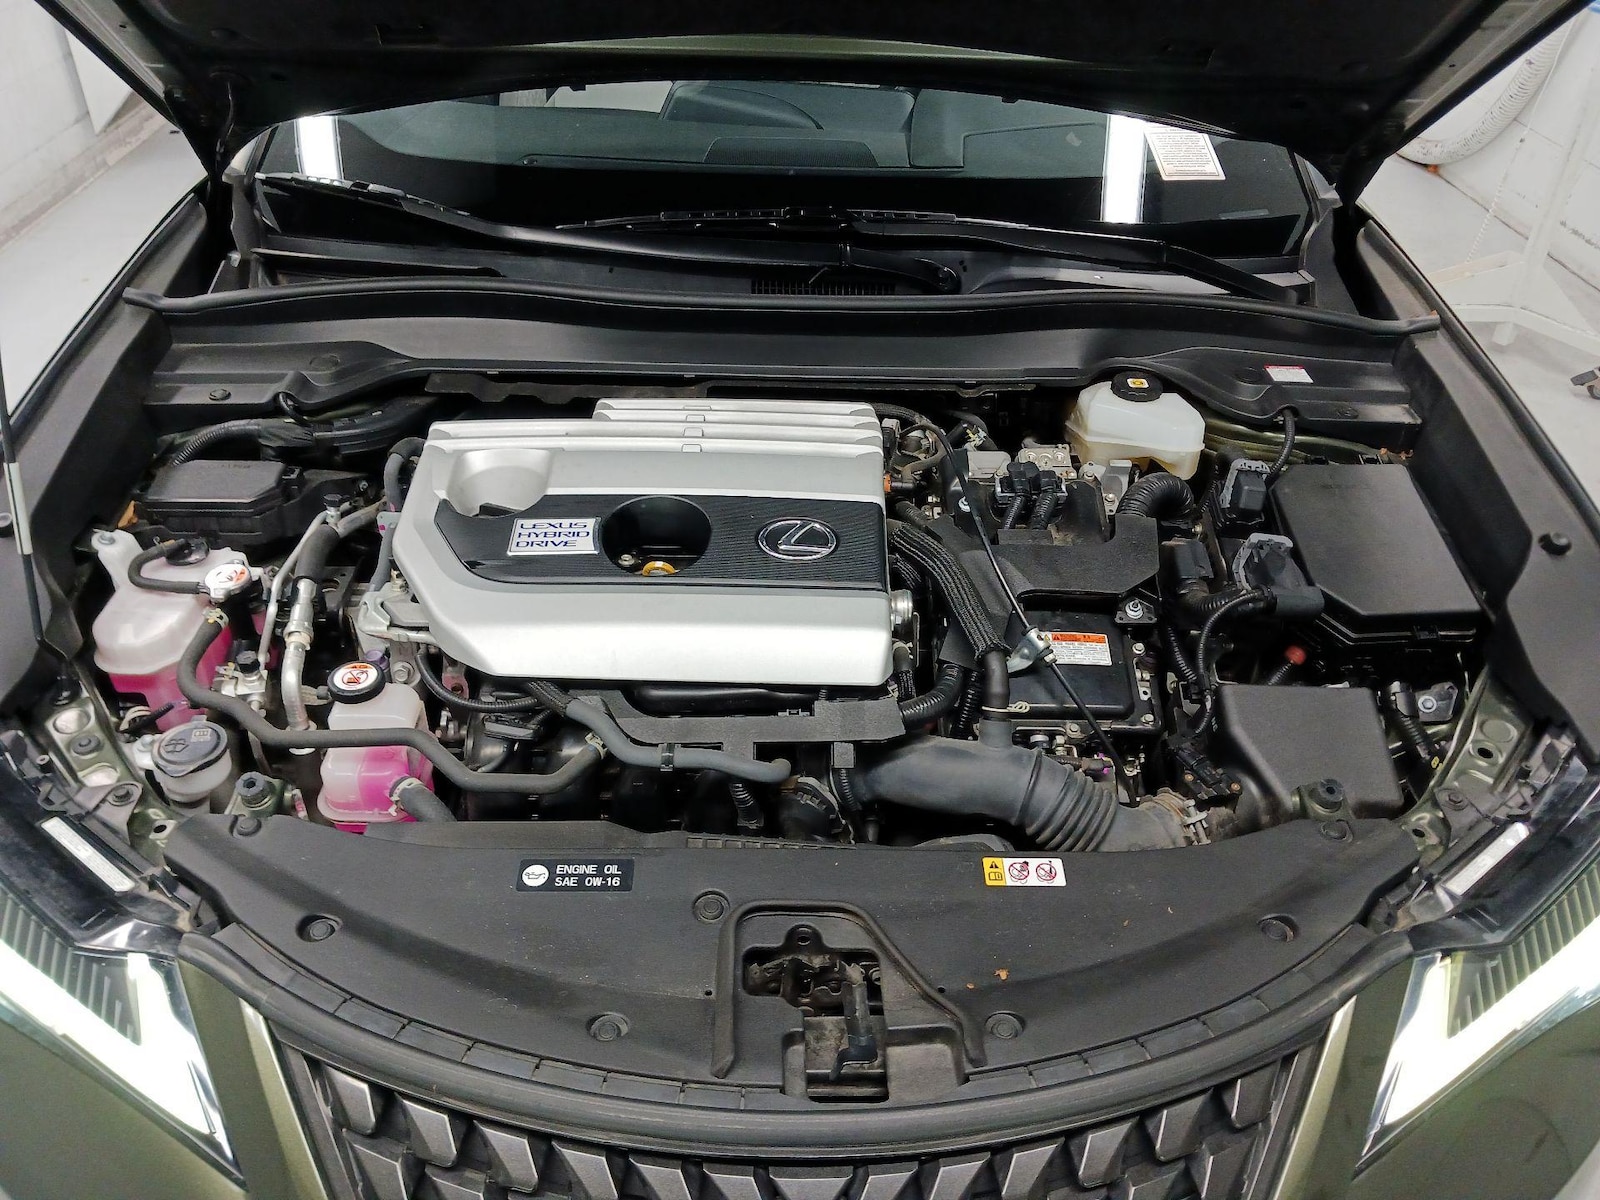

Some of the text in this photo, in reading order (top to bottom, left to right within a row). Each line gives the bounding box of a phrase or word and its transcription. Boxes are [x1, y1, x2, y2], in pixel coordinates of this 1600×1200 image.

[516, 540, 577, 548] DRIVE
[556, 864, 622, 874] ENGINE OIL
[555, 877, 621, 887] SAE 0W-16
